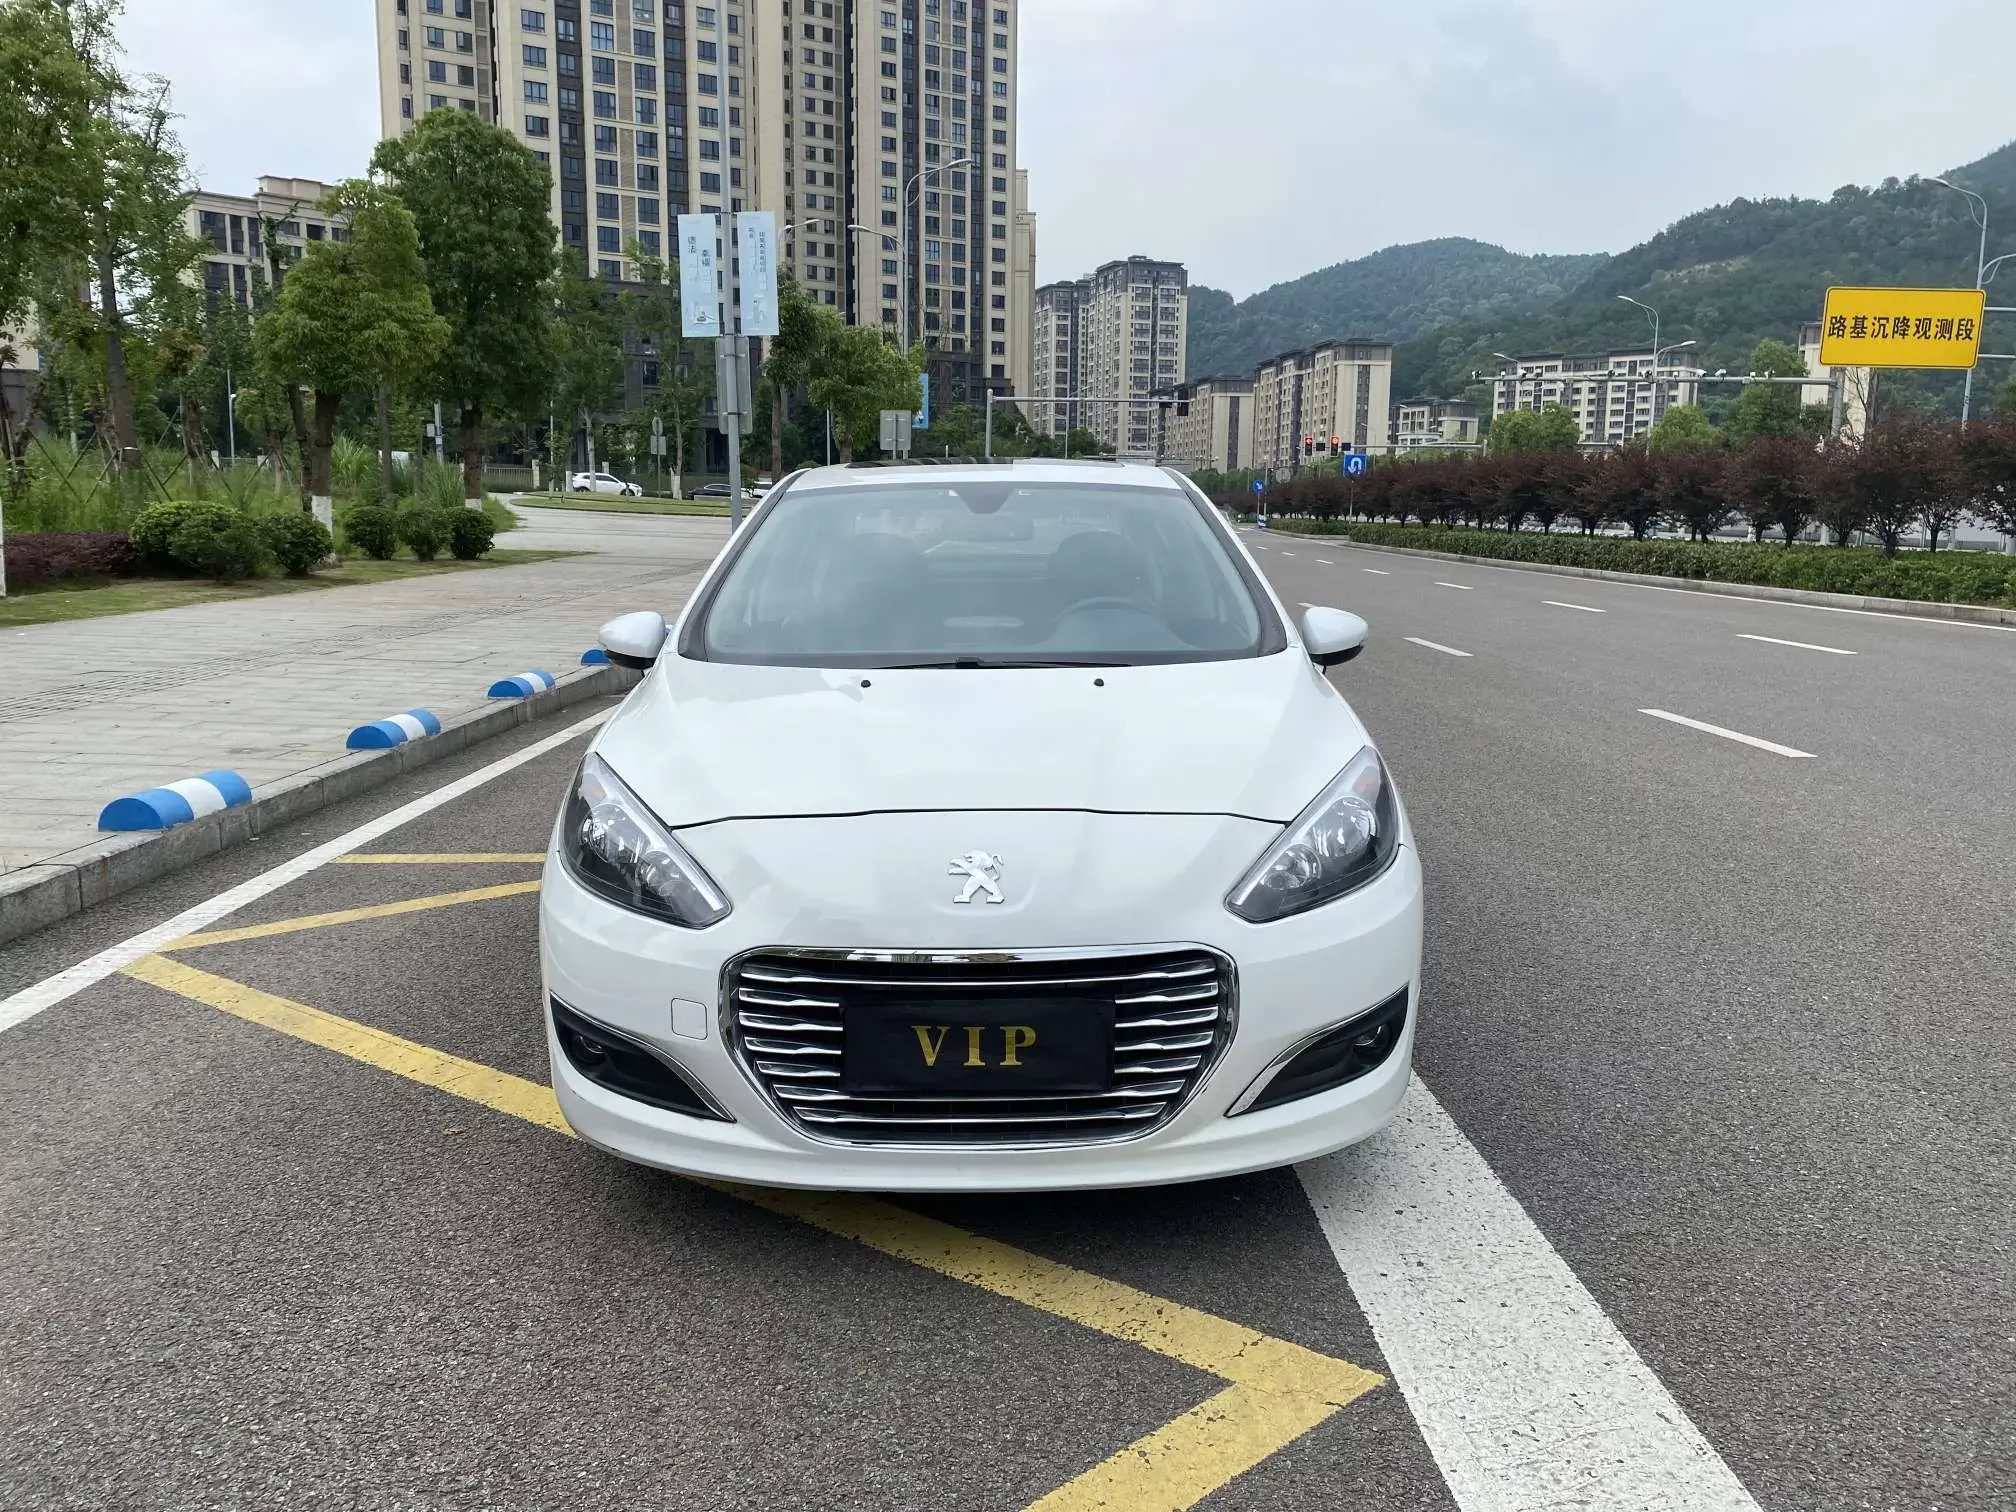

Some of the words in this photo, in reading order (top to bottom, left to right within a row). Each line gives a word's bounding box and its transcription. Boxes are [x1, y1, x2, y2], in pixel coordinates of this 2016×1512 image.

[1827, 315, 1976, 341] 路基沉降观测段
[911, 1025, 1037, 1067] VIP
